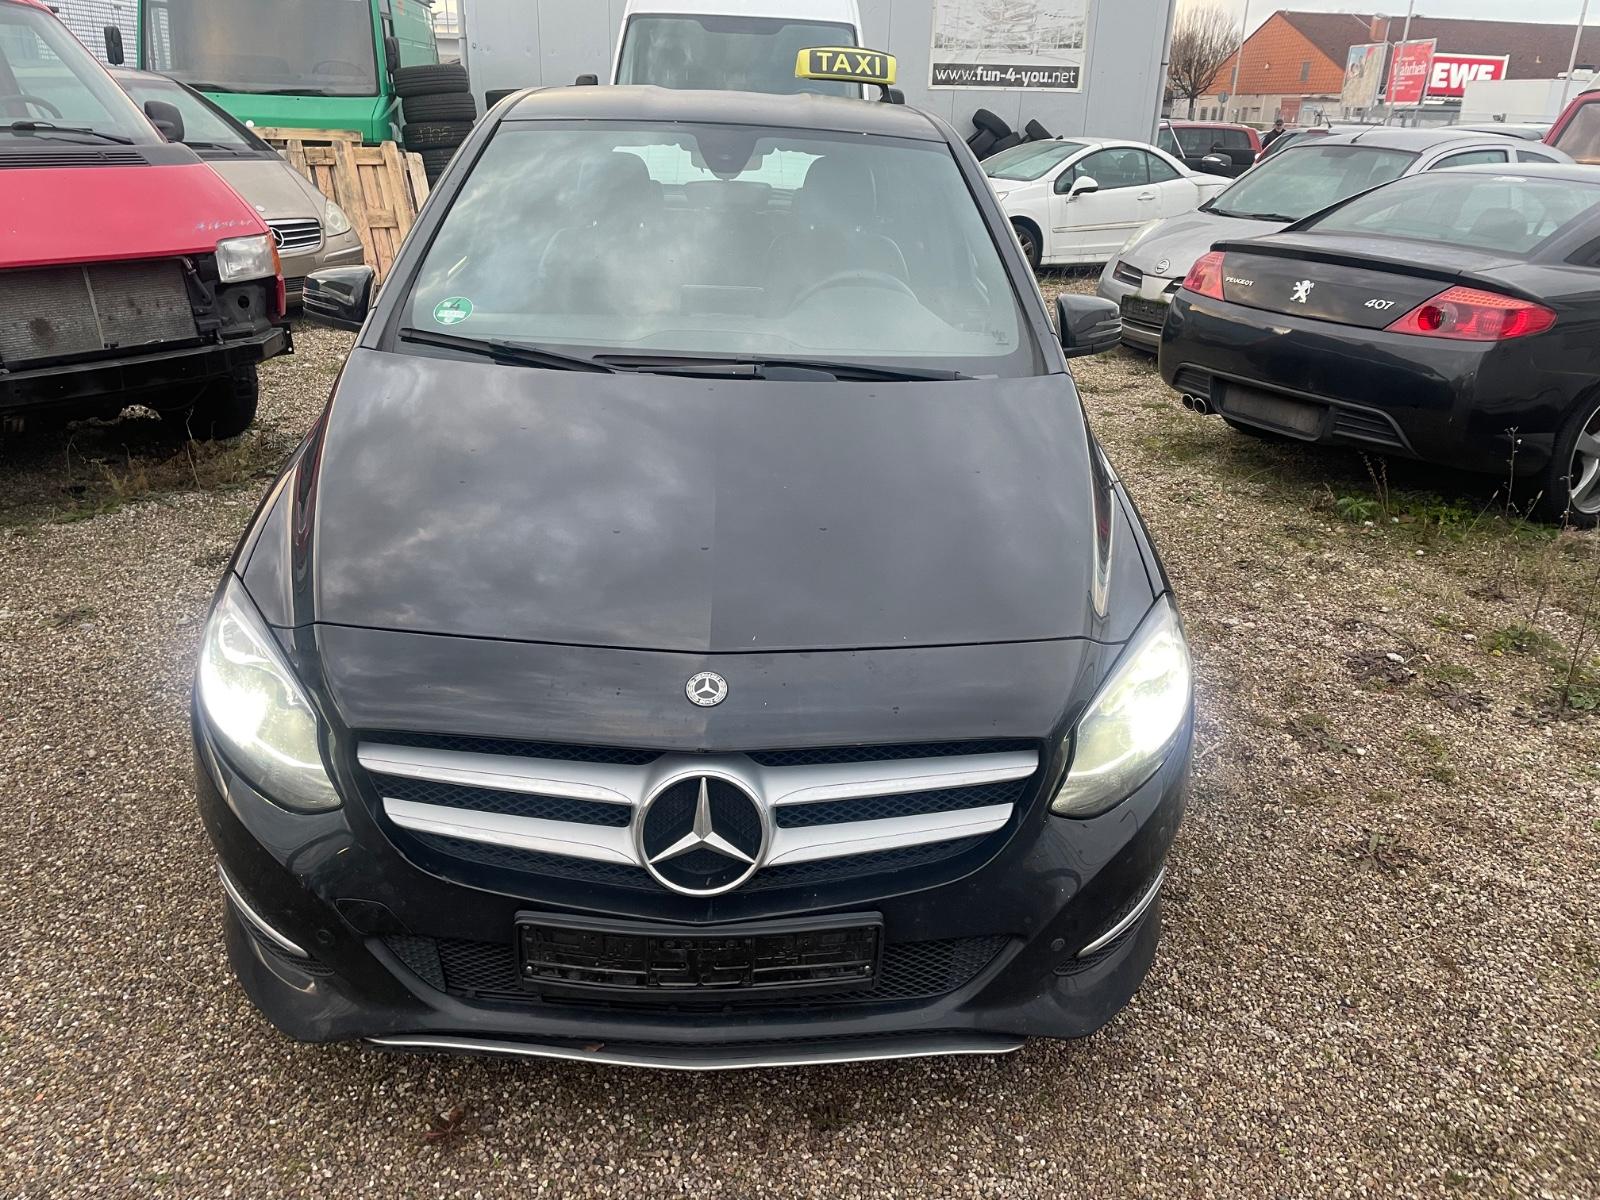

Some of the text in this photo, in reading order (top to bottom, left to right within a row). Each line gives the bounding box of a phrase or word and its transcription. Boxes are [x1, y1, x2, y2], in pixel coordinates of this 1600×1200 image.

[817, 52, 881, 75] TAXI
[935, 66, 1076, 86] www.fun-4-you.net
[1429, 63, 1495, 88] EWE
[1225, 276, 1254, 287] PEUGEOT
[1364, 298, 1395, 310] 407
